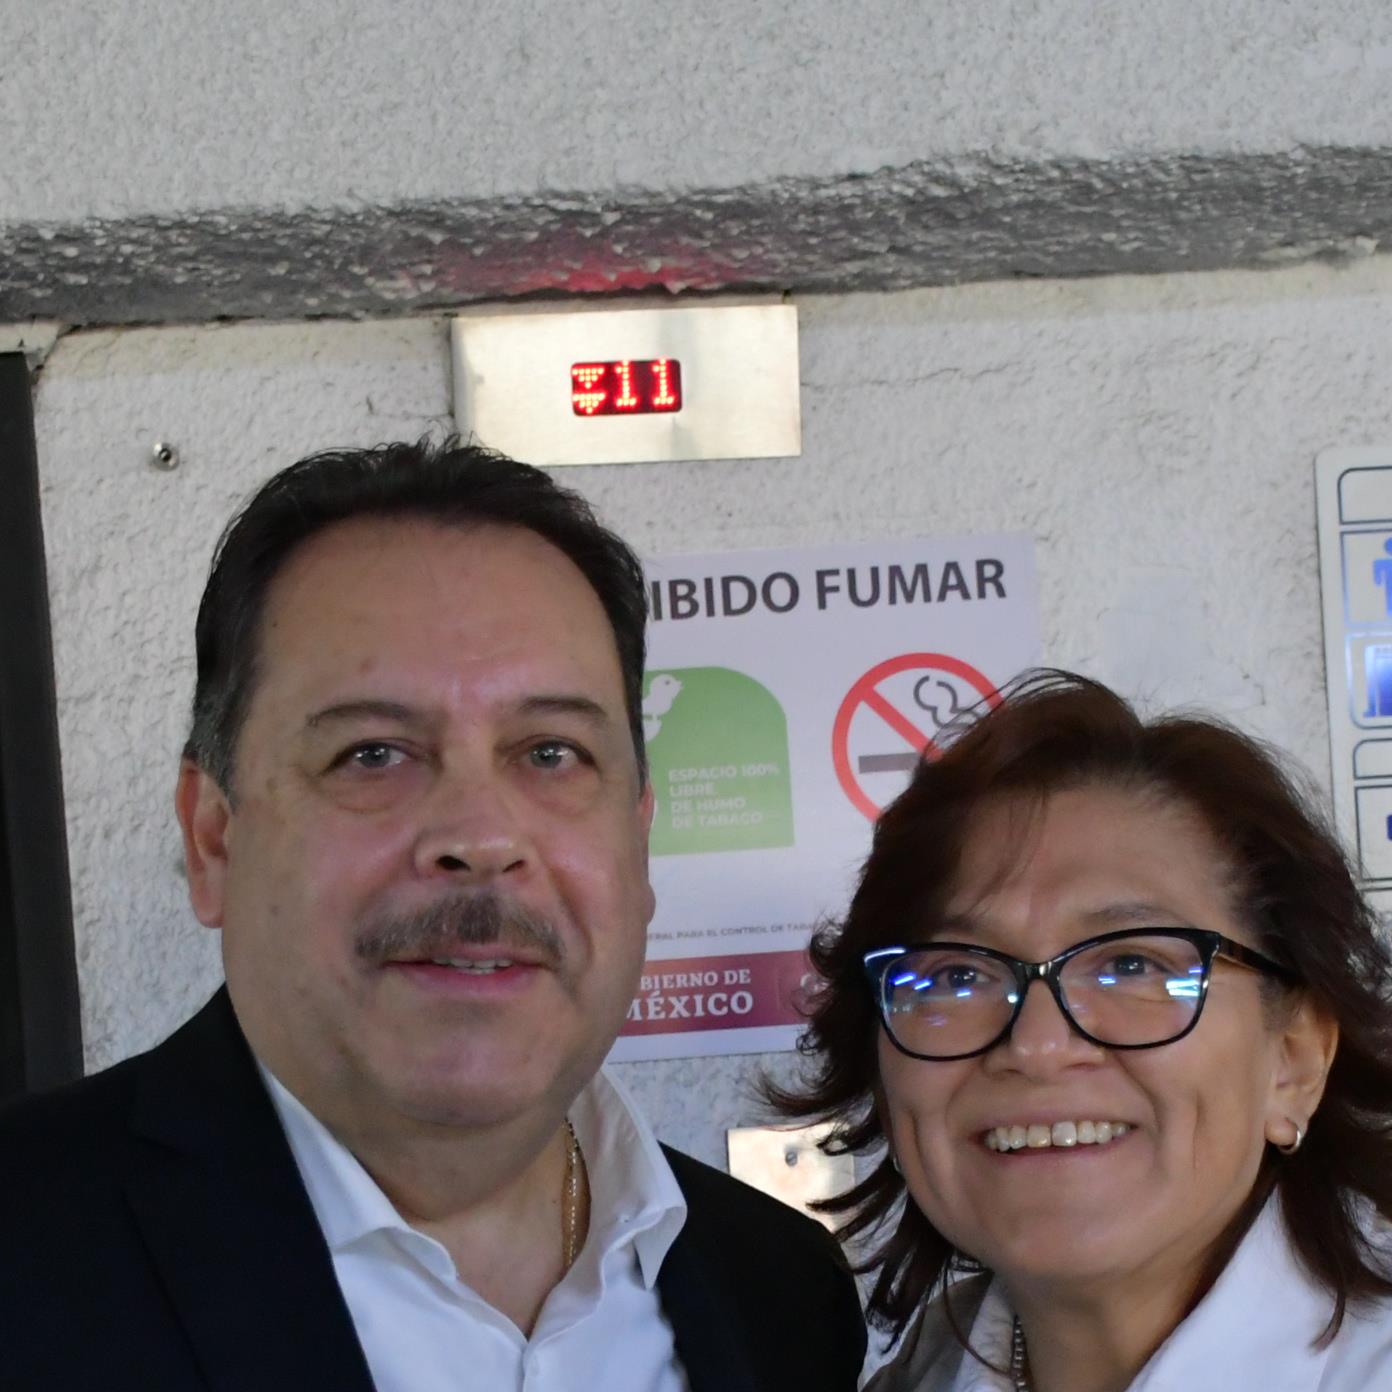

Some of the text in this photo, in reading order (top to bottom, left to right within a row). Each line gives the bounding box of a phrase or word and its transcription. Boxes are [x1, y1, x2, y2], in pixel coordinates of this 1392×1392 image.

[614, 358, 675, 406] 11
[651, 558, 1007, 622] IBIDO FUMAR
[668, 765, 738, 783] ESPACIO
[670, 782, 715, 798] LIBRE
[671, 796, 746, 813] DE HUMO
[672, 810, 763, 829] DE TABACO
[640, 969, 752, 991] BIERNO DE
